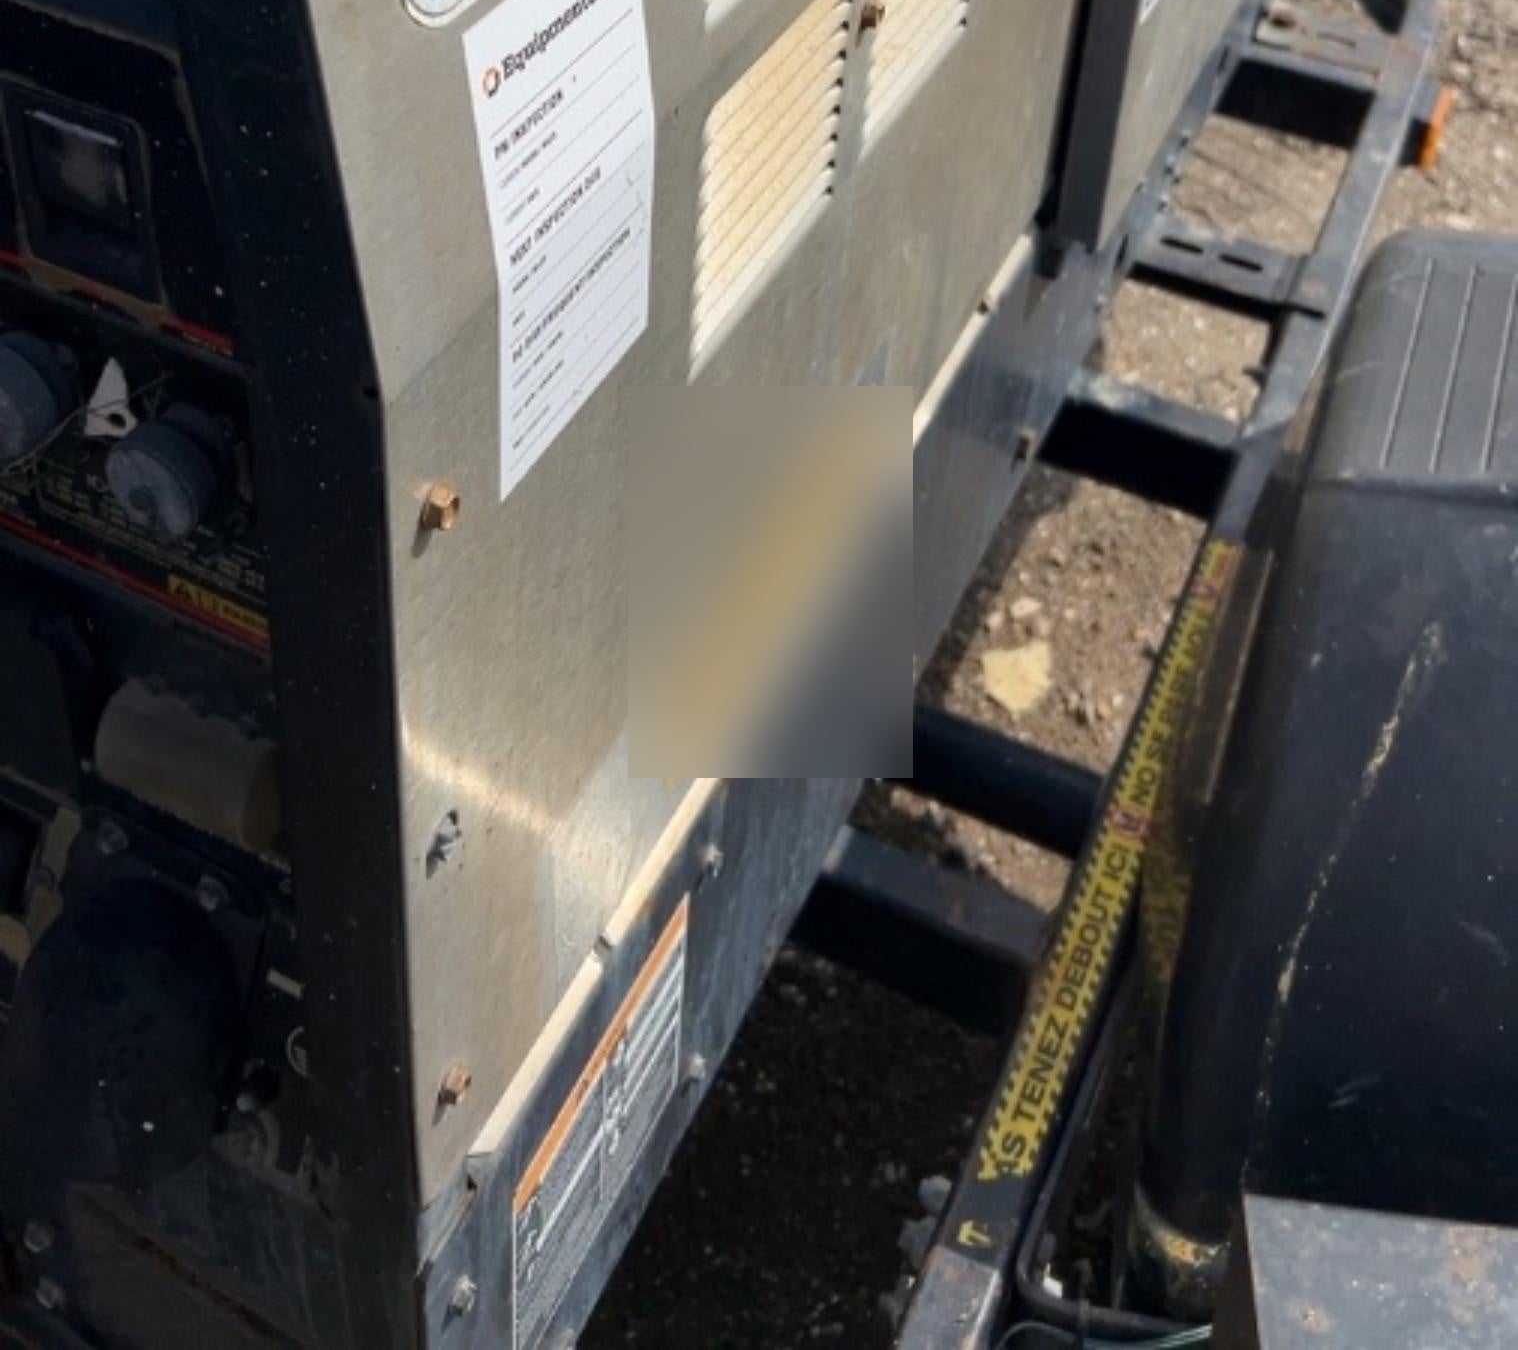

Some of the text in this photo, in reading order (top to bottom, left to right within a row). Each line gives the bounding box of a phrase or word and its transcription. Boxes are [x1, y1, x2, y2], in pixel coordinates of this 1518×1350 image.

[511, 88, 563, 144] INSPECTION
[533, 182, 583, 243] INSPECTION
[1129, 766, 1156, 804] NO
[1012, 1015, 1069, 1126] TENEZ
[1055, 887, 1118, 1012] DEBOUT
[1105, 838, 1132, 882] ICI
